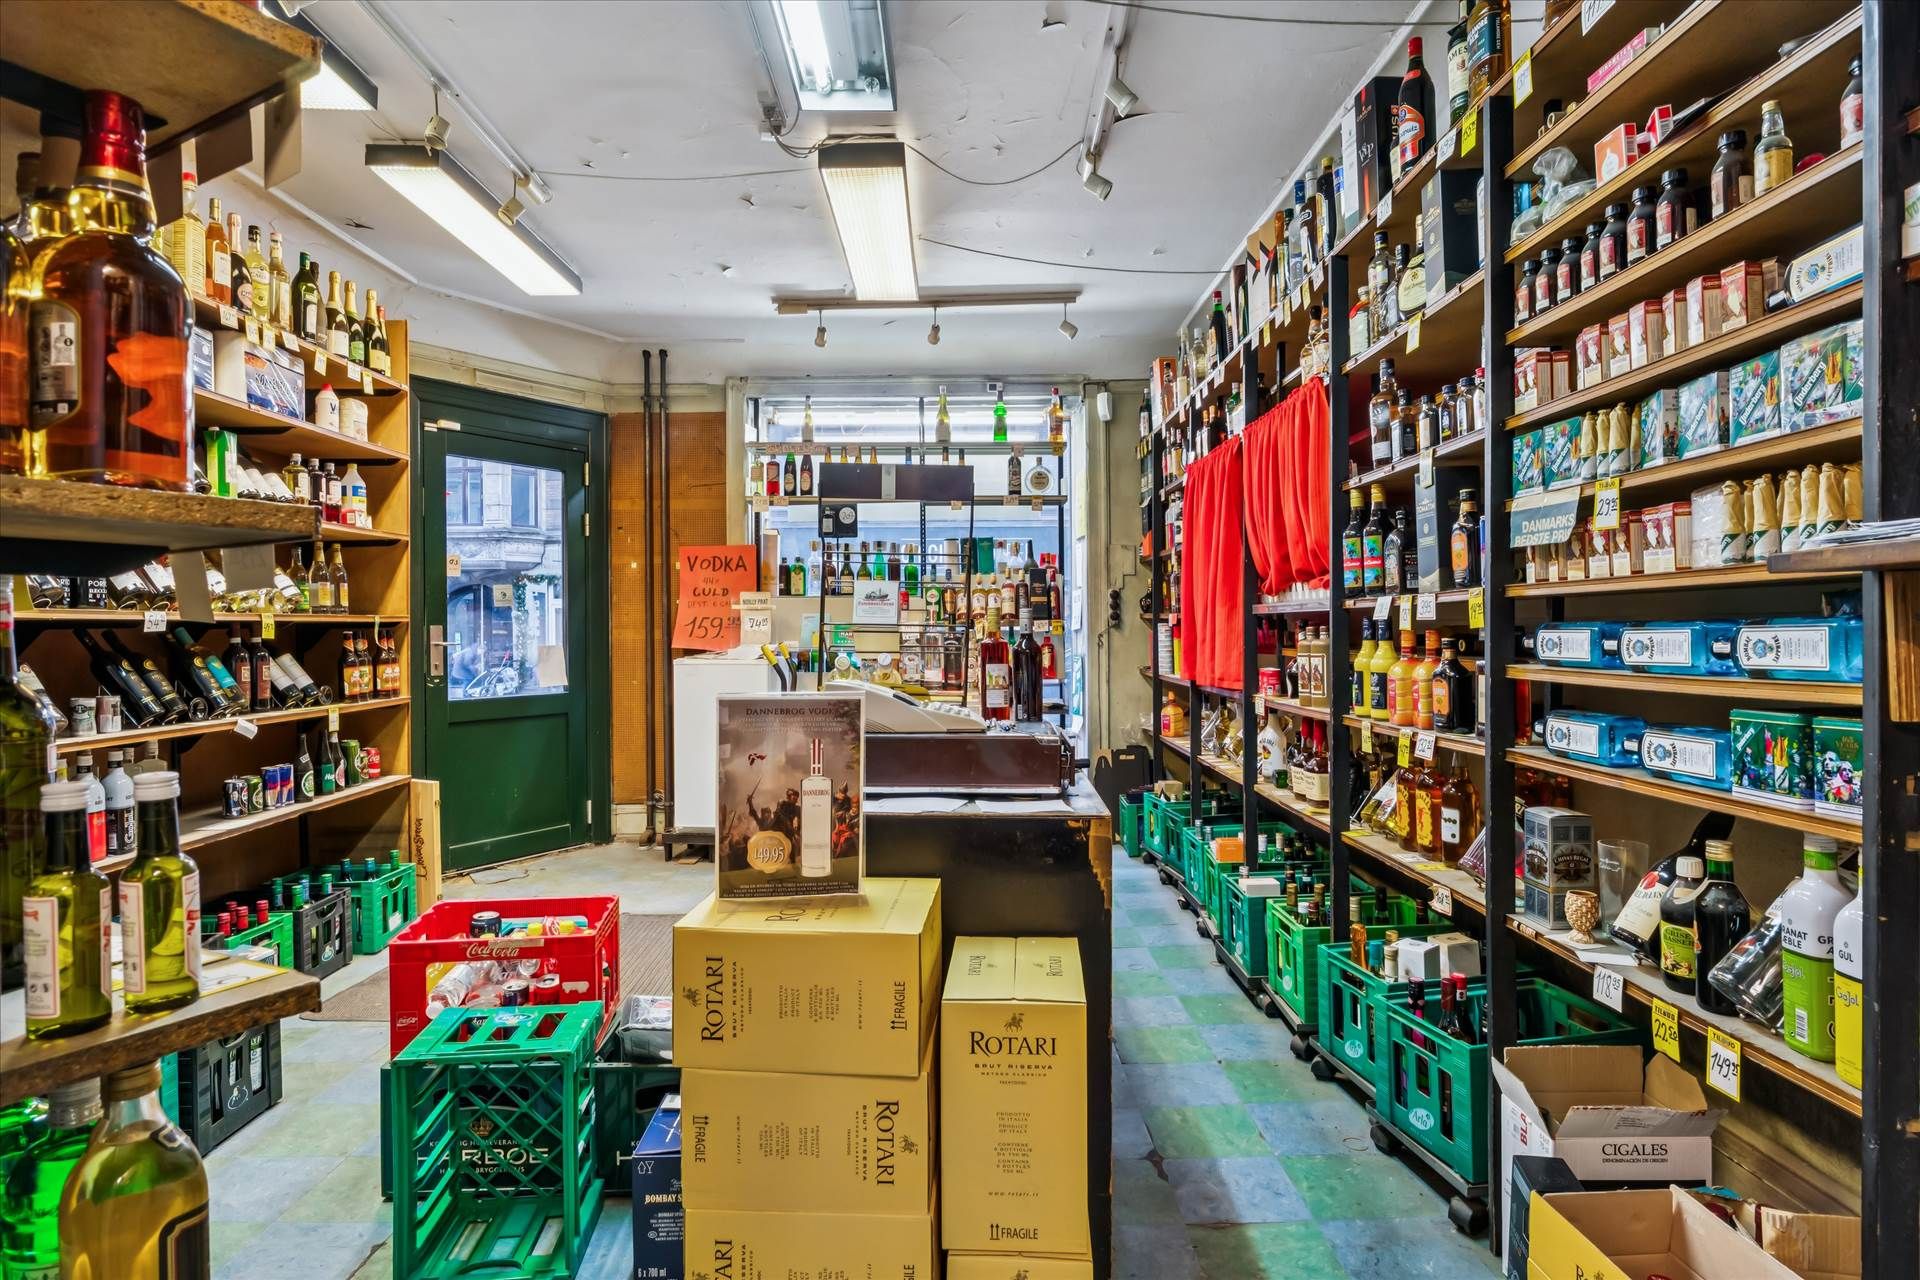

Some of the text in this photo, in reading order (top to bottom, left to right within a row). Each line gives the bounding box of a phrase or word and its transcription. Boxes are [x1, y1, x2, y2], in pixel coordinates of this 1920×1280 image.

[1794, 361, 1826, 407] Underberg
[1740, 384, 1766, 425] Underberg
[1522, 513, 1575, 534] DANMARKS
[1515, 533, 1550, 546] BEDSTE
[1773, 634, 1782, 664] SAPPHIRE
[746, 708, 804, 716] DANNEBROG
[752, 846, 784, 862] 149.95
[1783, 924, 1808, 942] RANAT
[466, 943, 520, 958] Coca-Cola
[1838, 949, 1854, 964] GUL
[702, 956, 724, 1042] ROTARI
[894, 981, 906, 1018] FRAGILE
[970, 1030, 1056, 1057] ROTARI
[1411, 1110, 1432, 1129] Arla
[695, 1126, 706, 1163] FRAGILE
[874, 1100, 899, 1187] ROTARI
[1602, 1144, 1668, 1156] CIGALES
[645, 1194, 676, 1204] BOMBAY
[1001, 1227, 1038, 1240] FRAGILE
[660, 1268, 666, 1277] ml
